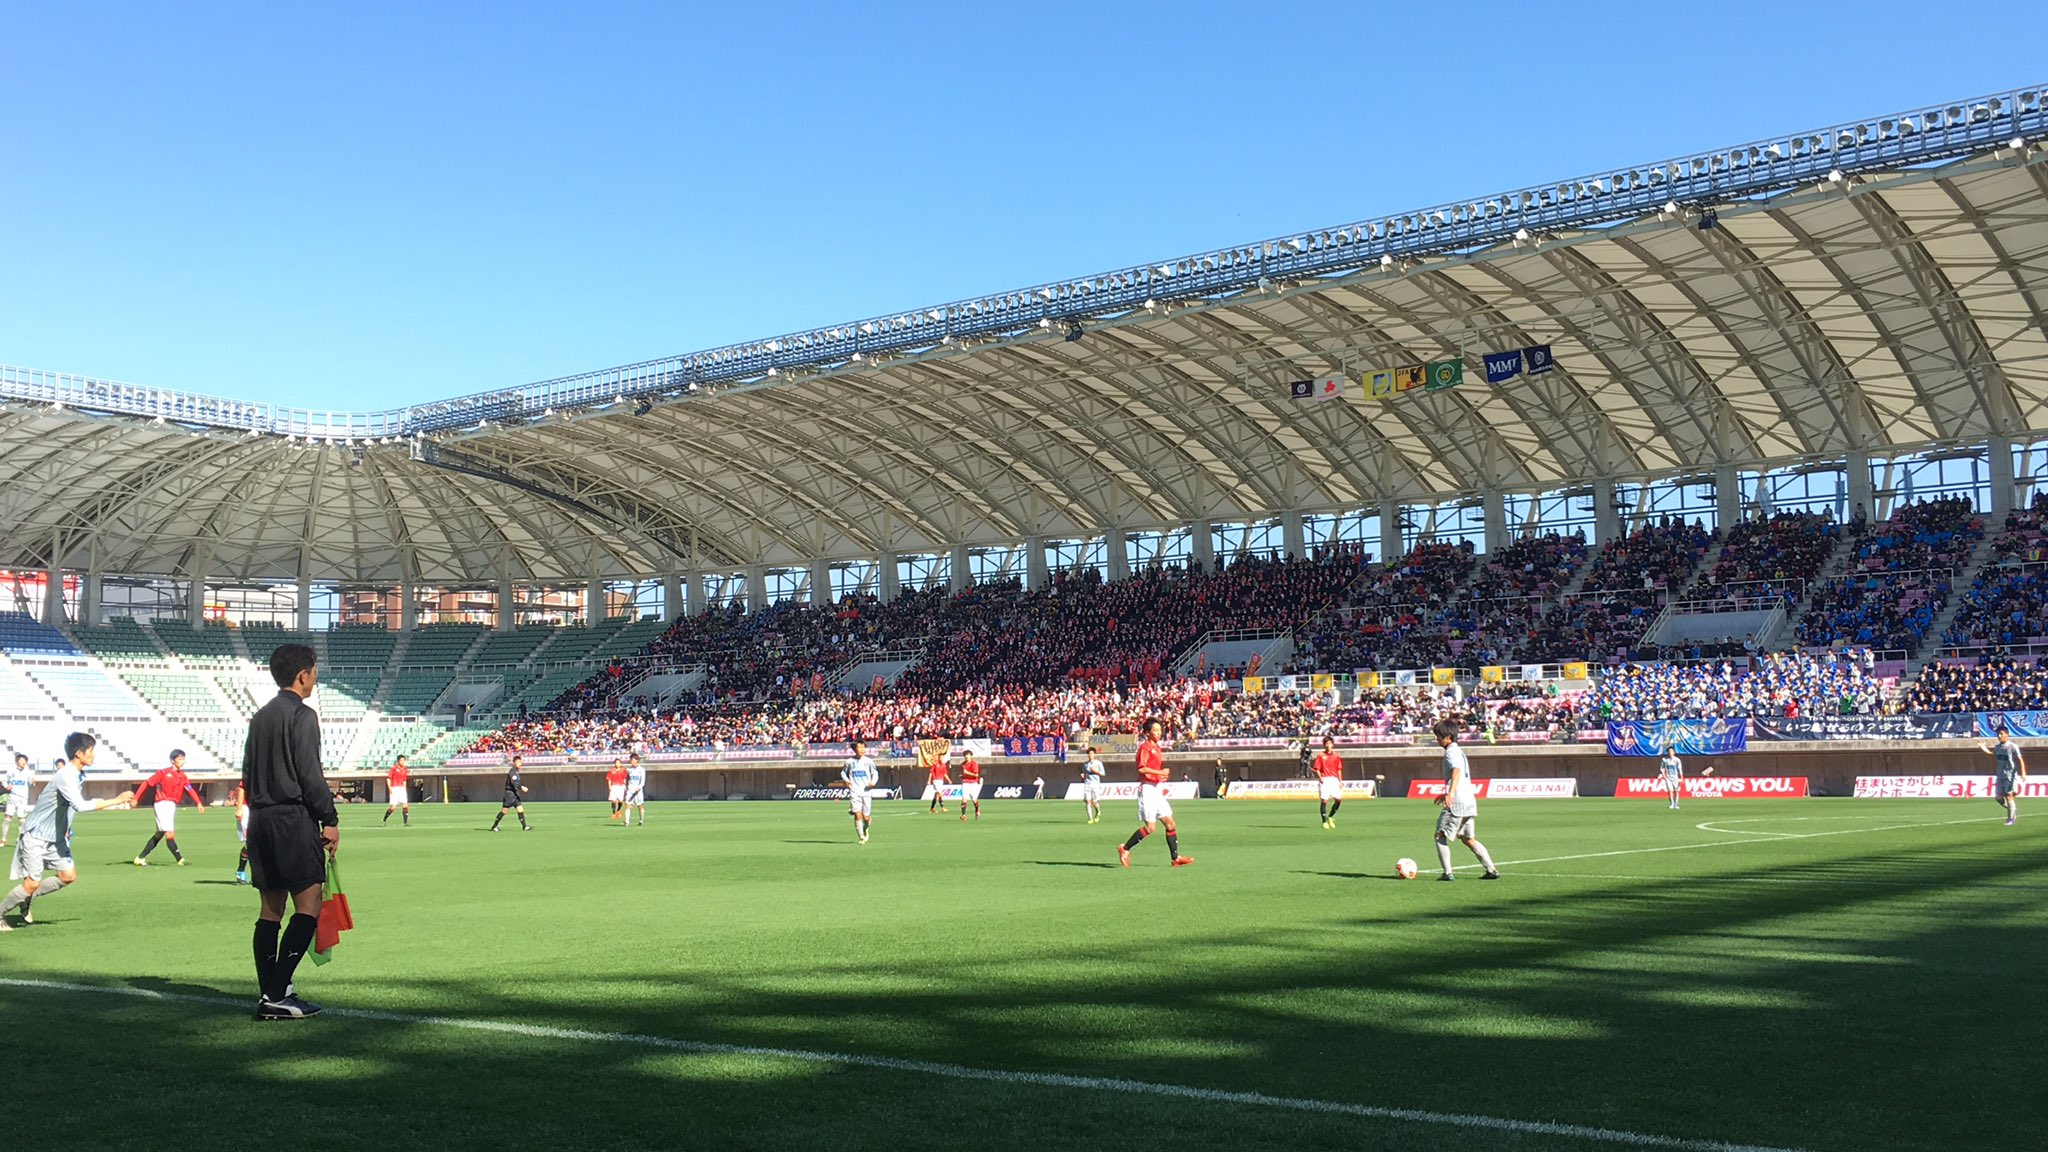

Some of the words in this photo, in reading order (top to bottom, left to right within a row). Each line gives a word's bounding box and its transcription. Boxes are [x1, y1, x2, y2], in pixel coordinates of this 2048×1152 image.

[1397, 369, 1410, 377] JFA
[1115, 743, 1137, 753] GOLD
[1496, 784, 1527, 793] DAKE
[1628, 779, 1679, 792] WHA
[1685, 778, 1744, 792] WOWS
[1750, 777, 1794, 791] YOU.
[1948, 780, 1976, 797] at
